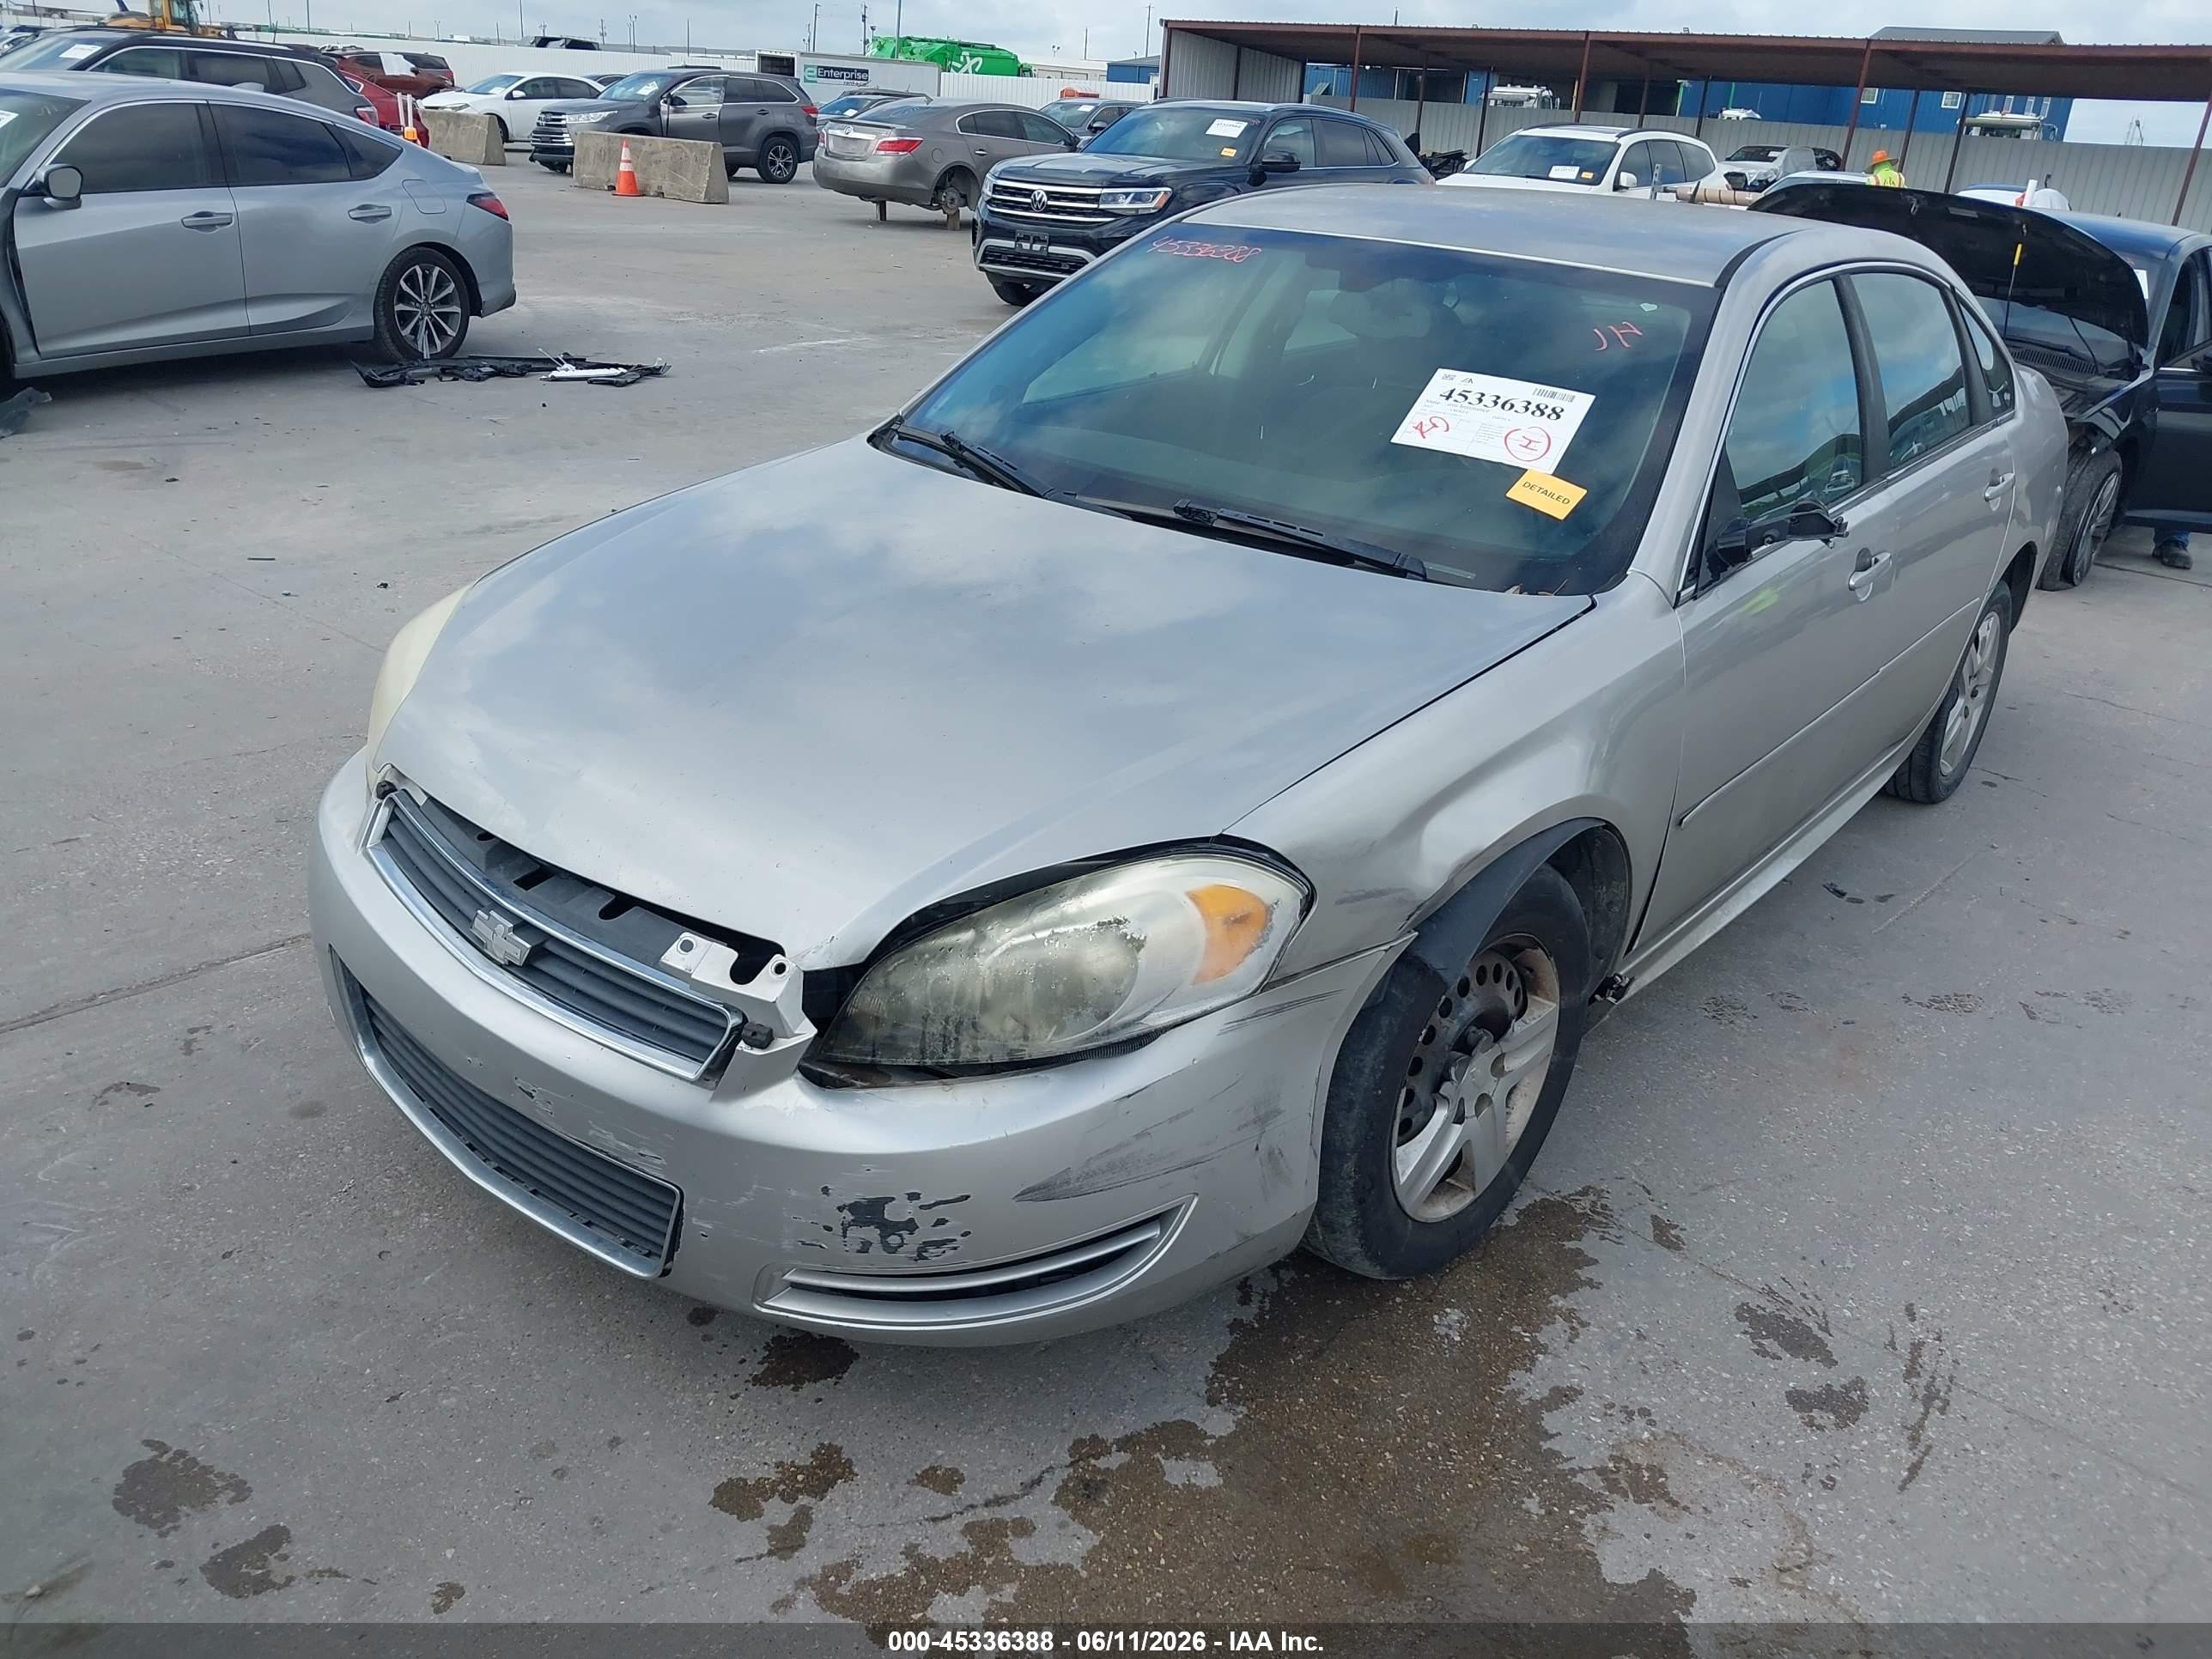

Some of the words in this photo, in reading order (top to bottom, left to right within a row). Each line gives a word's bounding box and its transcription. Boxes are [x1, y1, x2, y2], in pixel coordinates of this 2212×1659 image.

[817, 67, 869, 81] Enterprise
[1439, 387, 1565, 421] 45336388
[1522, 481, 1571, 505] DETAILED
